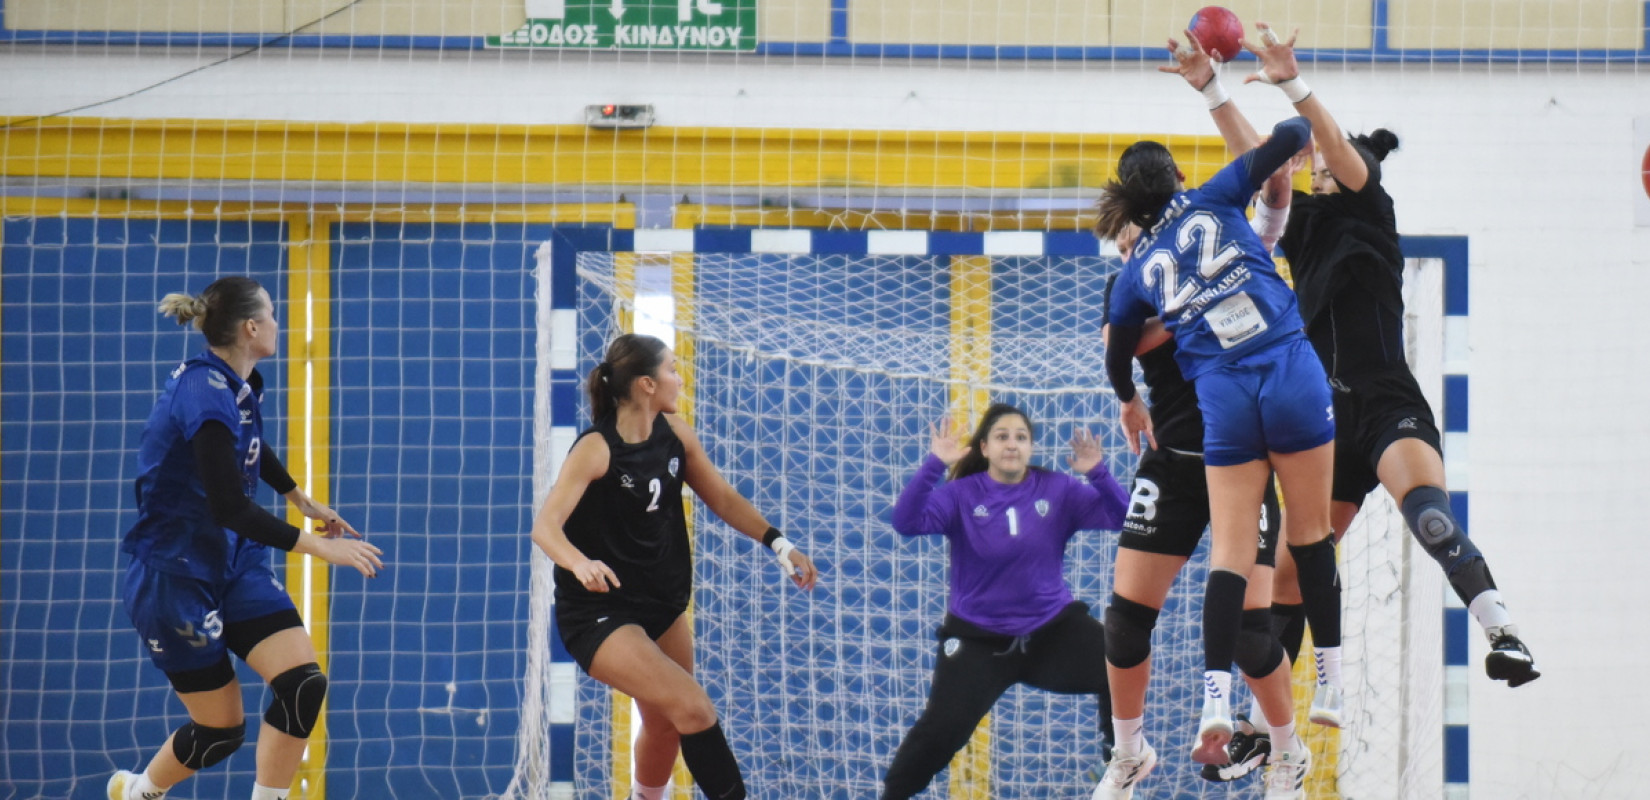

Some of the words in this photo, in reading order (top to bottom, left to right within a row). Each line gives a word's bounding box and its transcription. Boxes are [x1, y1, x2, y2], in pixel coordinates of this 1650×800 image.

[615, 25, 742, 46] ΚΙΝΔΥΝΟΥ
[1142, 210, 1246, 314] 22
[1218, 306, 1251, 328] VINTAGE
[244, 437, 260, 466] 9
[645, 478, 661, 512] 2
[1126, 477, 1160, 521] B
[1005, 506, 1018, 536] 1
